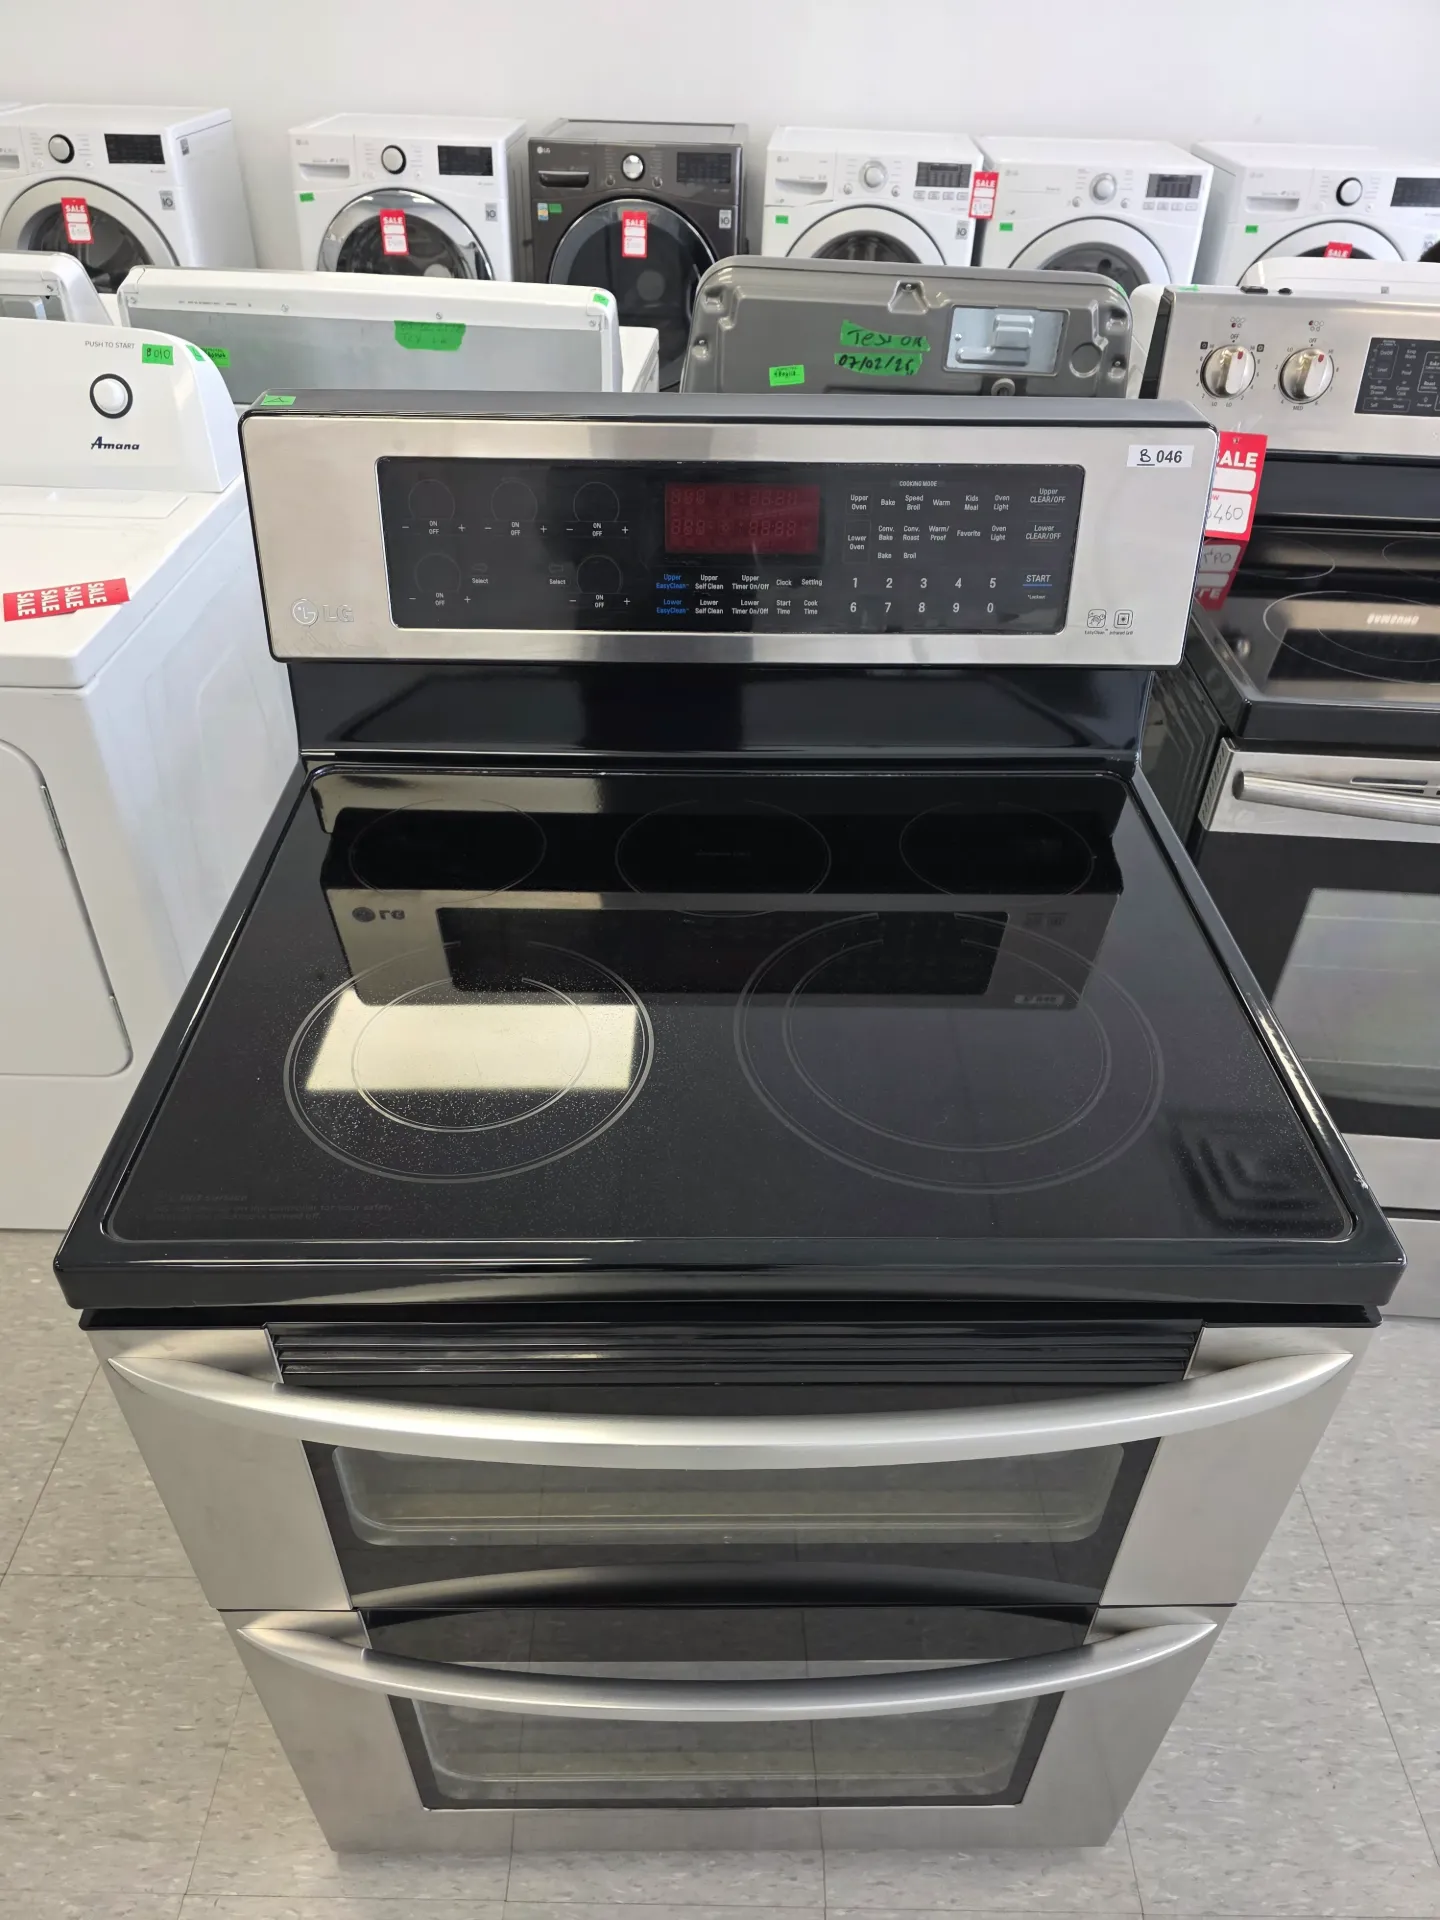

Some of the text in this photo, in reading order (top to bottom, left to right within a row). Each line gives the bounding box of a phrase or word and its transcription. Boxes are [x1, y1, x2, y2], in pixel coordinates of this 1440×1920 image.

[975, 179, 996, 187] SALE
[65, 204, 85, 212] SALE
[383, 216, 403, 224] SALE
[625, 218, 645, 226] SALE
[1327, 249, 1348, 257] SALE
[105, 341, 114, 349] TO
[90, 436, 140, 450] Amana
[1140, 449, 1183, 464] B 046
[1039, 488, 1059, 496] Upper
[1030, 496, 1066, 504] CLEAR/OFF
[993, 503, 1009, 511] Light
[990, 534, 1006, 542] Light
[1025, 532, 1061, 540] CLEAR/OFF
[700, 574, 718, 582] Upper
[741, 574, 759, 582] Upper
[1026, 575, 1051, 583] START
[749, 583, 770, 591] On/Off
[801, 579, 823, 587] Setting
[853, 578, 996, 588] 1 2 3 4 5
[64, 585, 84, 609] SALE
[88, 582, 108, 605] SALE
[17, 592, 36, 617] SALE
[41, 589, 60, 613] SALE
[850, 602, 994, 613] 6 7 8 9 0
